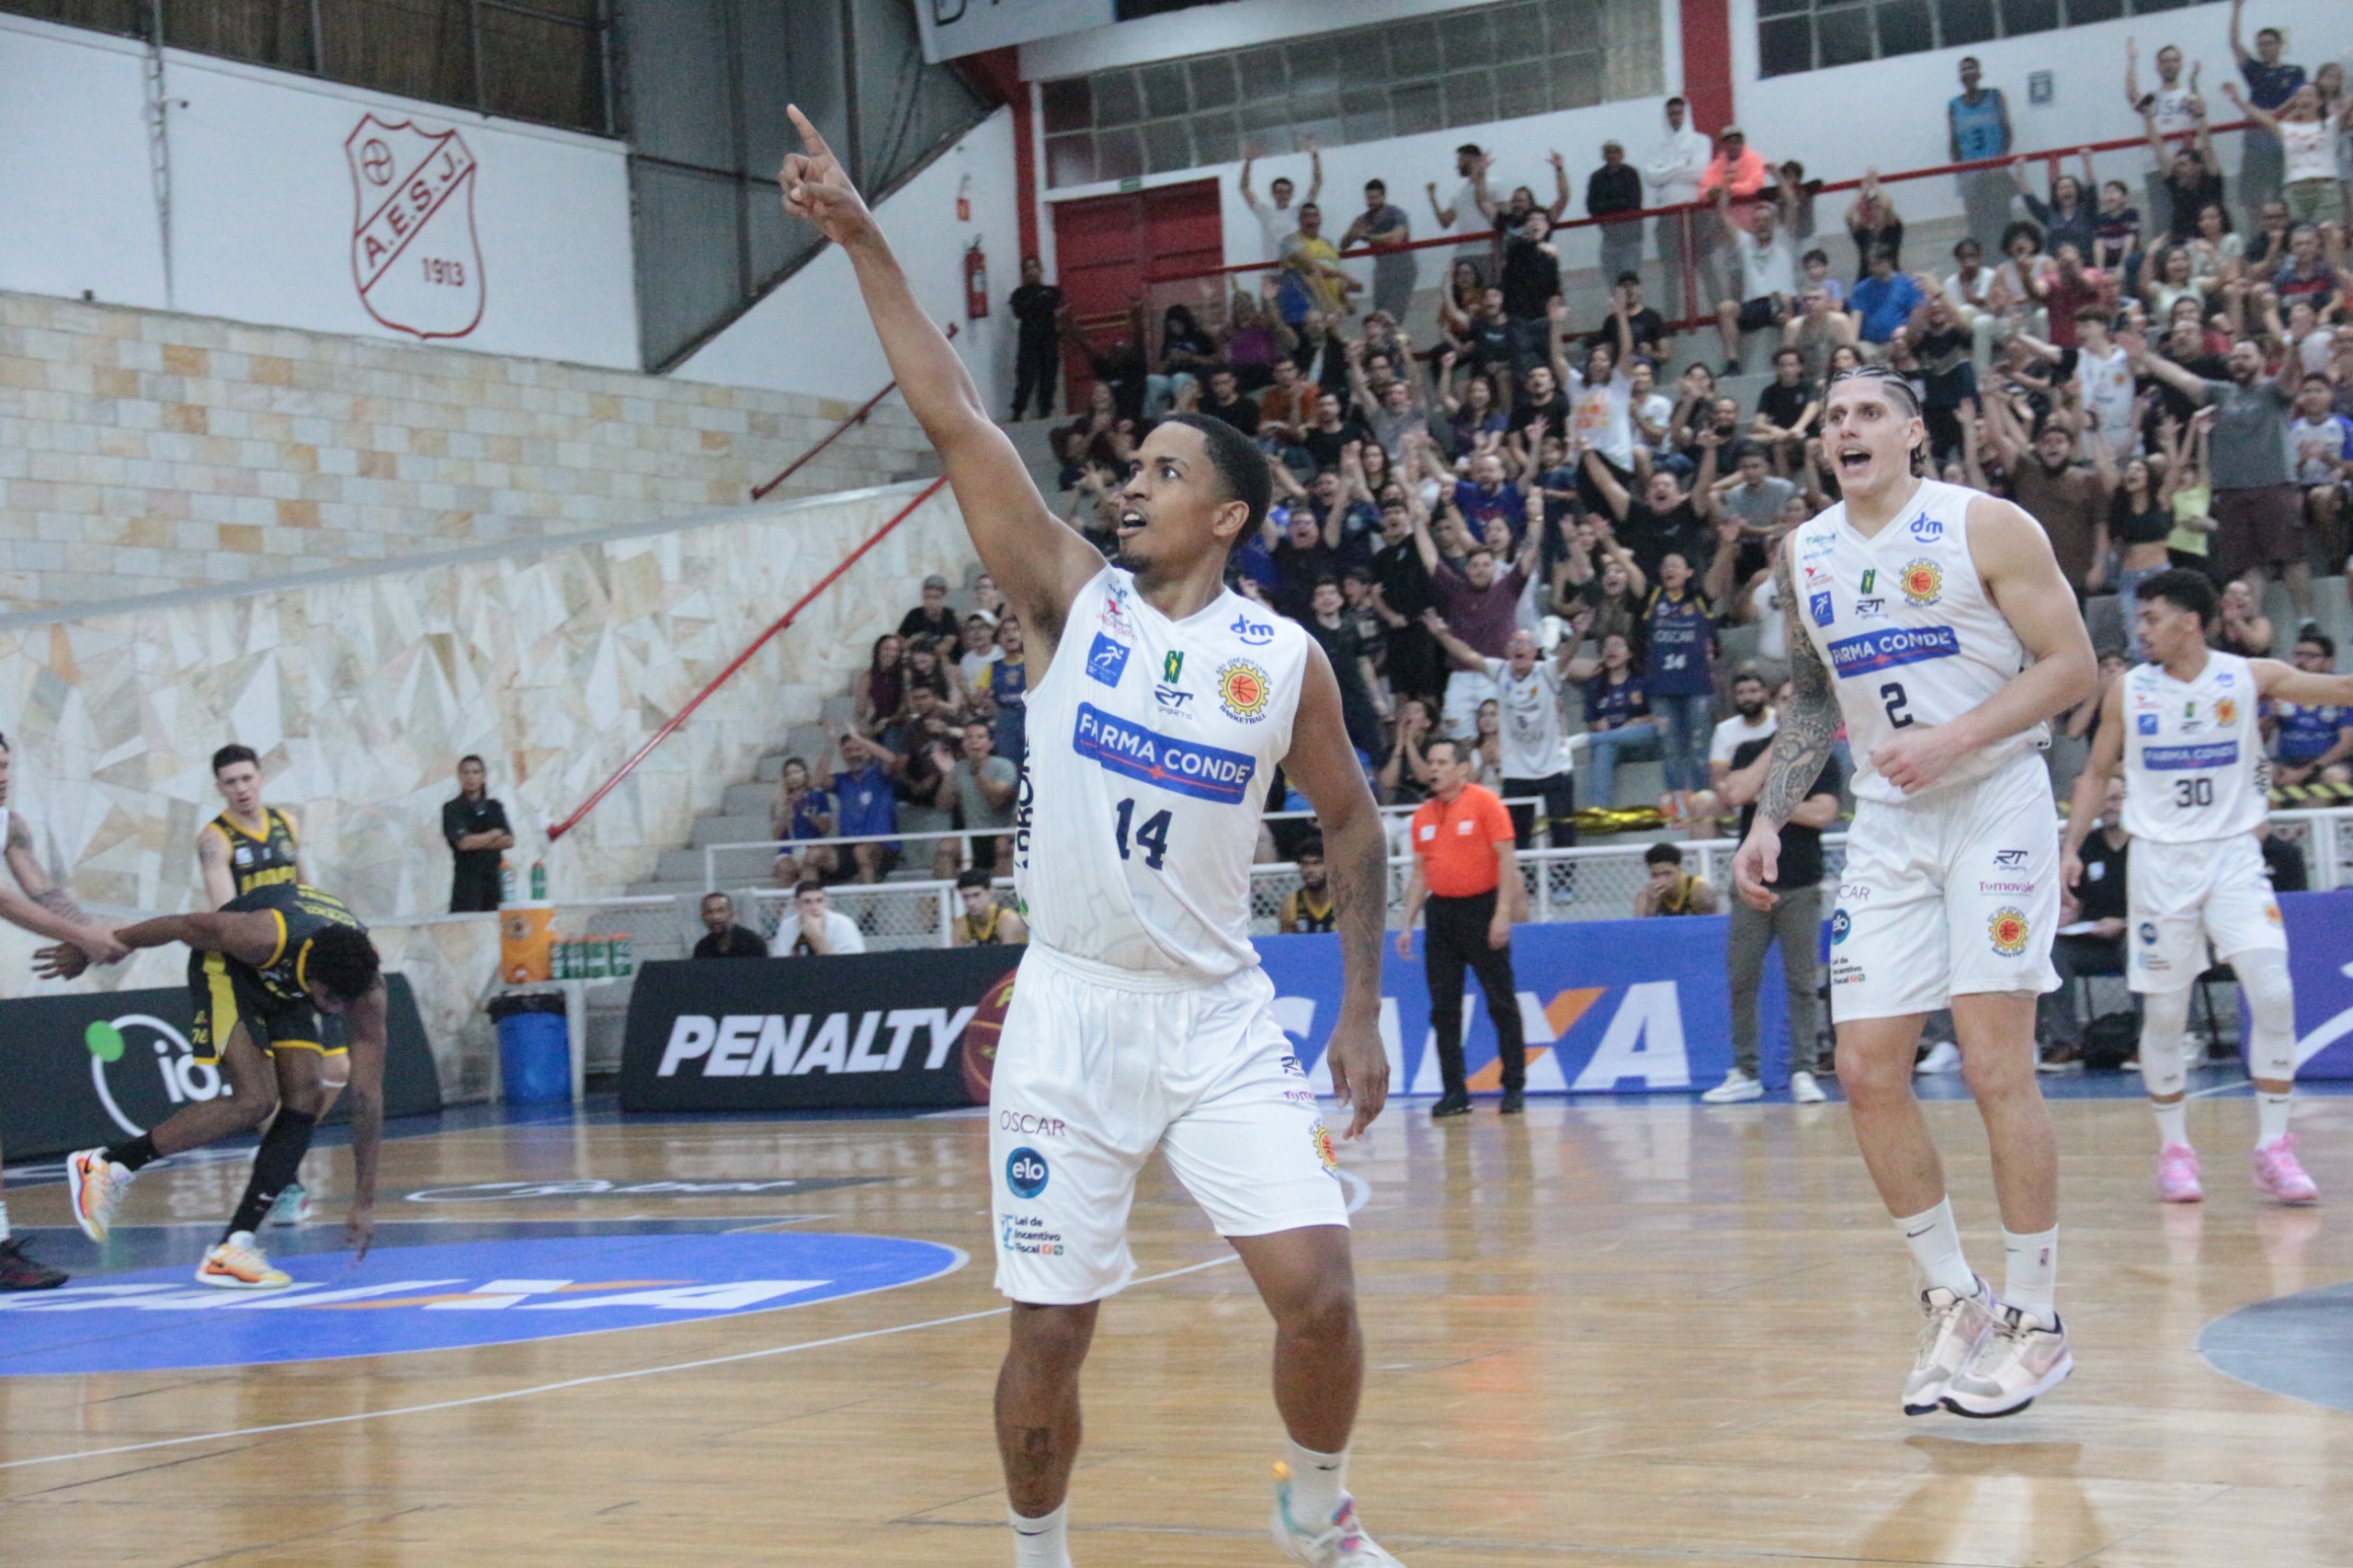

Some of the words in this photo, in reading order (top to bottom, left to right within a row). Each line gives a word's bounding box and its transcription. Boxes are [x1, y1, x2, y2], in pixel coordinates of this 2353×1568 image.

[365, 151, 464, 269] A.E.S.J.
[422, 256, 466, 288] 1913
[1879, 631, 1951, 653] CONDE
[1880, 681, 1915, 730] 2
[1079, 713, 1156, 763] FARMA
[1164, 749, 1251, 784] CONDE
[2175, 778, 2213, 808] 30
[1116, 797, 1173, 871] 14
[1839, 883, 1871, 902] CAR
[657, 1006, 978, 1077] PENALTY
[1000, 1109, 1066, 1138] OSCAR
[1012, 1157, 1045, 1181] elo
[1014, 1230, 1062, 1243] Incentivo
[1015, 1216, 1029, 1226] Lei
[1029, 1217, 1043, 1227] de
